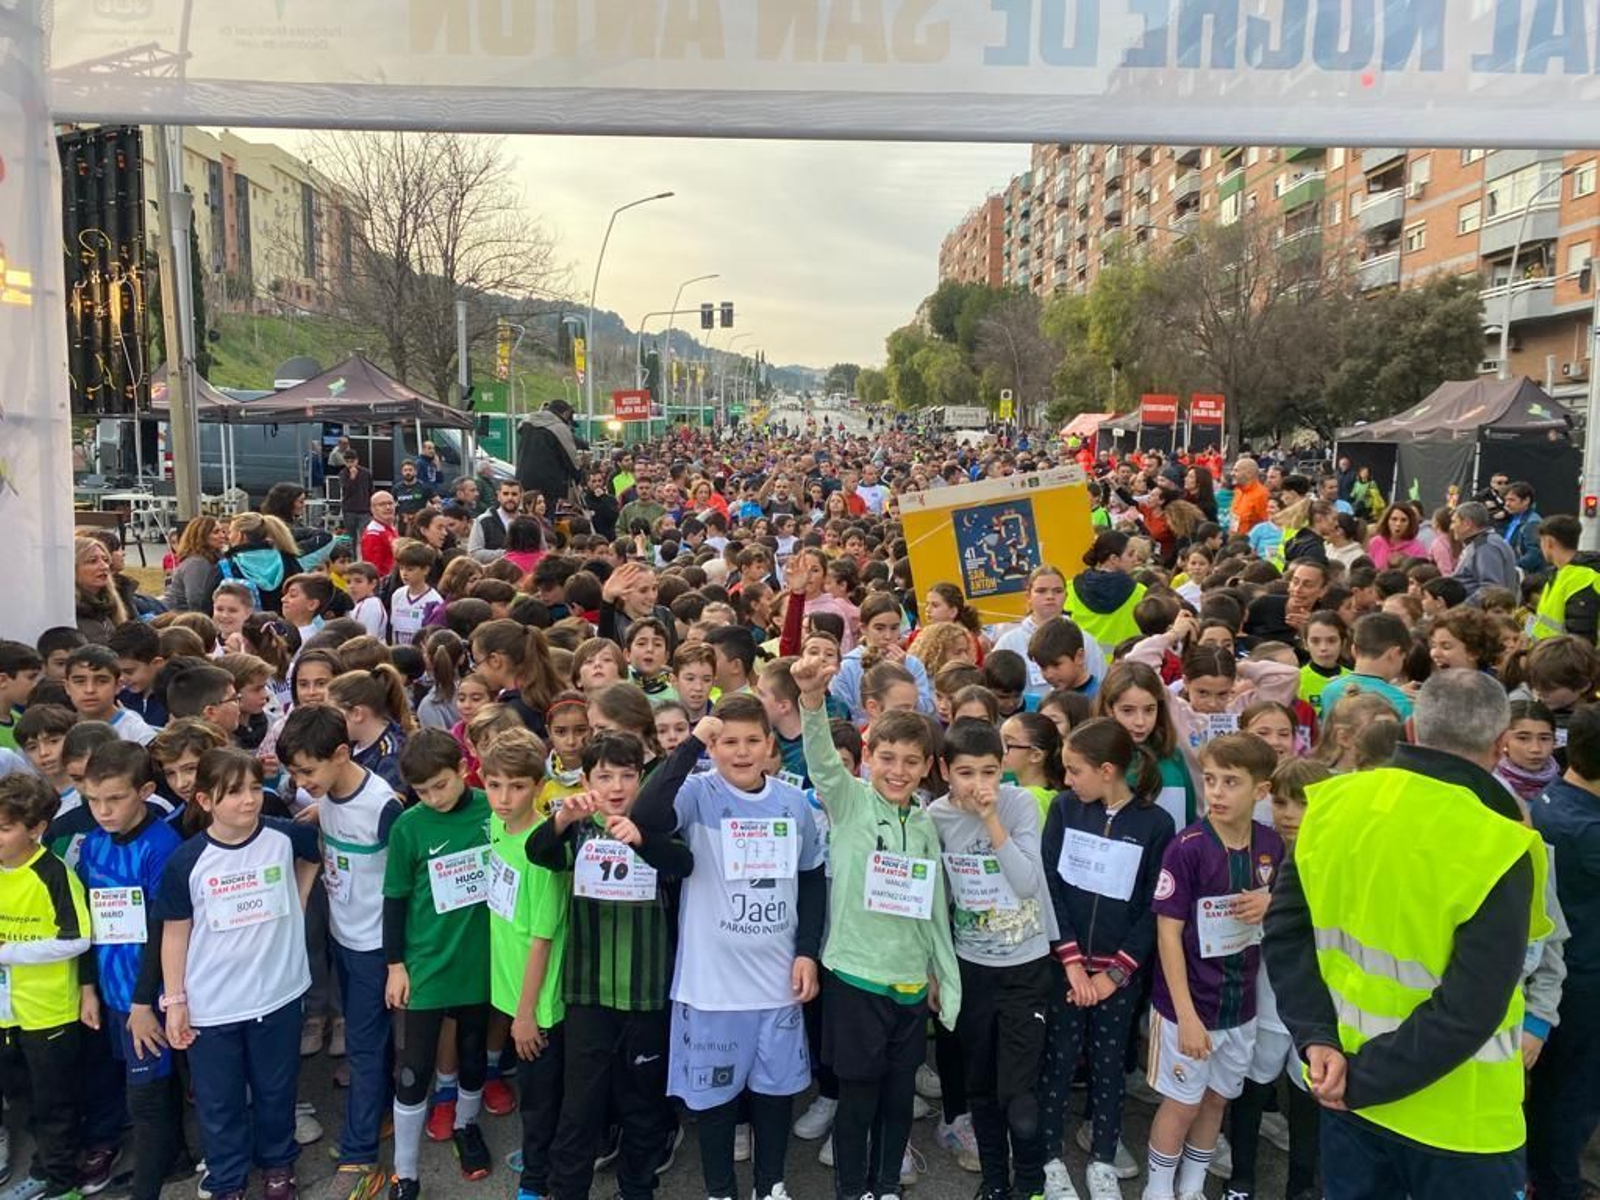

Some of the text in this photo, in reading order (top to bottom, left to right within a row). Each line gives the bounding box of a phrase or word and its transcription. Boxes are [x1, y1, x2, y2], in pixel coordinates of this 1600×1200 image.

[455, 869, 485, 884] HUGO
[599, 861, 629, 882] 10
[466, 885, 478, 895] 10
[236, 899, 263, 912] 8000
[731, 893, 787, 922] Jaén
[101, 911, 124, 919] MARIO
[719, 920, 761, 935] PARAÍSO
